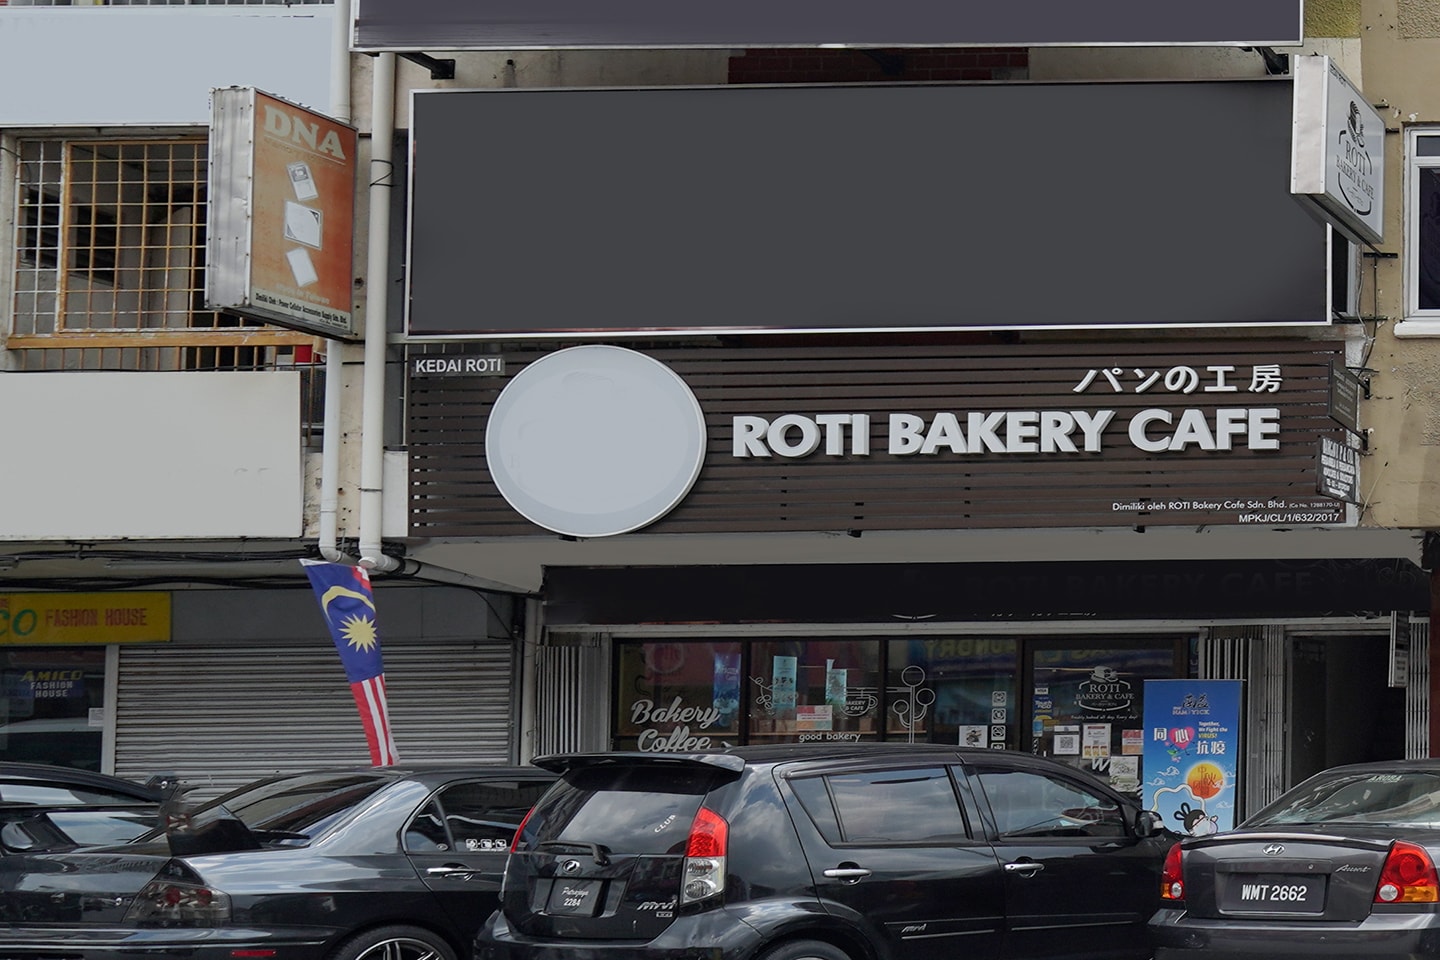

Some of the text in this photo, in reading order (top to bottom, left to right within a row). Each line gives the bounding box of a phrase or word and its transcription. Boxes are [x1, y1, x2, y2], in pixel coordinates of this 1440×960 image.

[263, 105, 346, 160] DNA
[1345, 140, 1366, 177] ROTI
[415, 358, 501, 373] KEDAI ROTI
[1072, 364, 1284, 394] パンの工房
[732, 413, 870, 458] ROTI
[888, 409, 1117, 456] BAKERY
[1128, 407, 1281, 453] CAFE
[1112, 501, 1145, 511] Dimiliki
[1147, 501, 1166, 511] oleh
[1169, 501, 1190, 510] ROTI
[1193, 501, 1222, 511] Bakery
[1224, 500, 1245, 510] Cafe
[1247, 500, 1265, 509] Sdn.
[1267, 500, 1287, 509] Bhd.
[1239, 512, 1340, 523] MPKJ/CL/1/632/2017
[45, 607, 149, 628] FASHION HOUSE
[20, 670, 83, 682] AMICO
[30, 681, 73, 690] FASHION
[1089, 683, 1120, 693] ROTI
[35, 690, 68, 698] HOUSE
[631, 695, 722, 729] Bakery
[799, 731, 861, 743] good bakery
[1196, 740, 1226, 755] 抗疫
[654, 814, 676, 833] CLUB
[1241, 884, 1307, 901] WMT 2662
[563, 897, 581, 907] 2284
